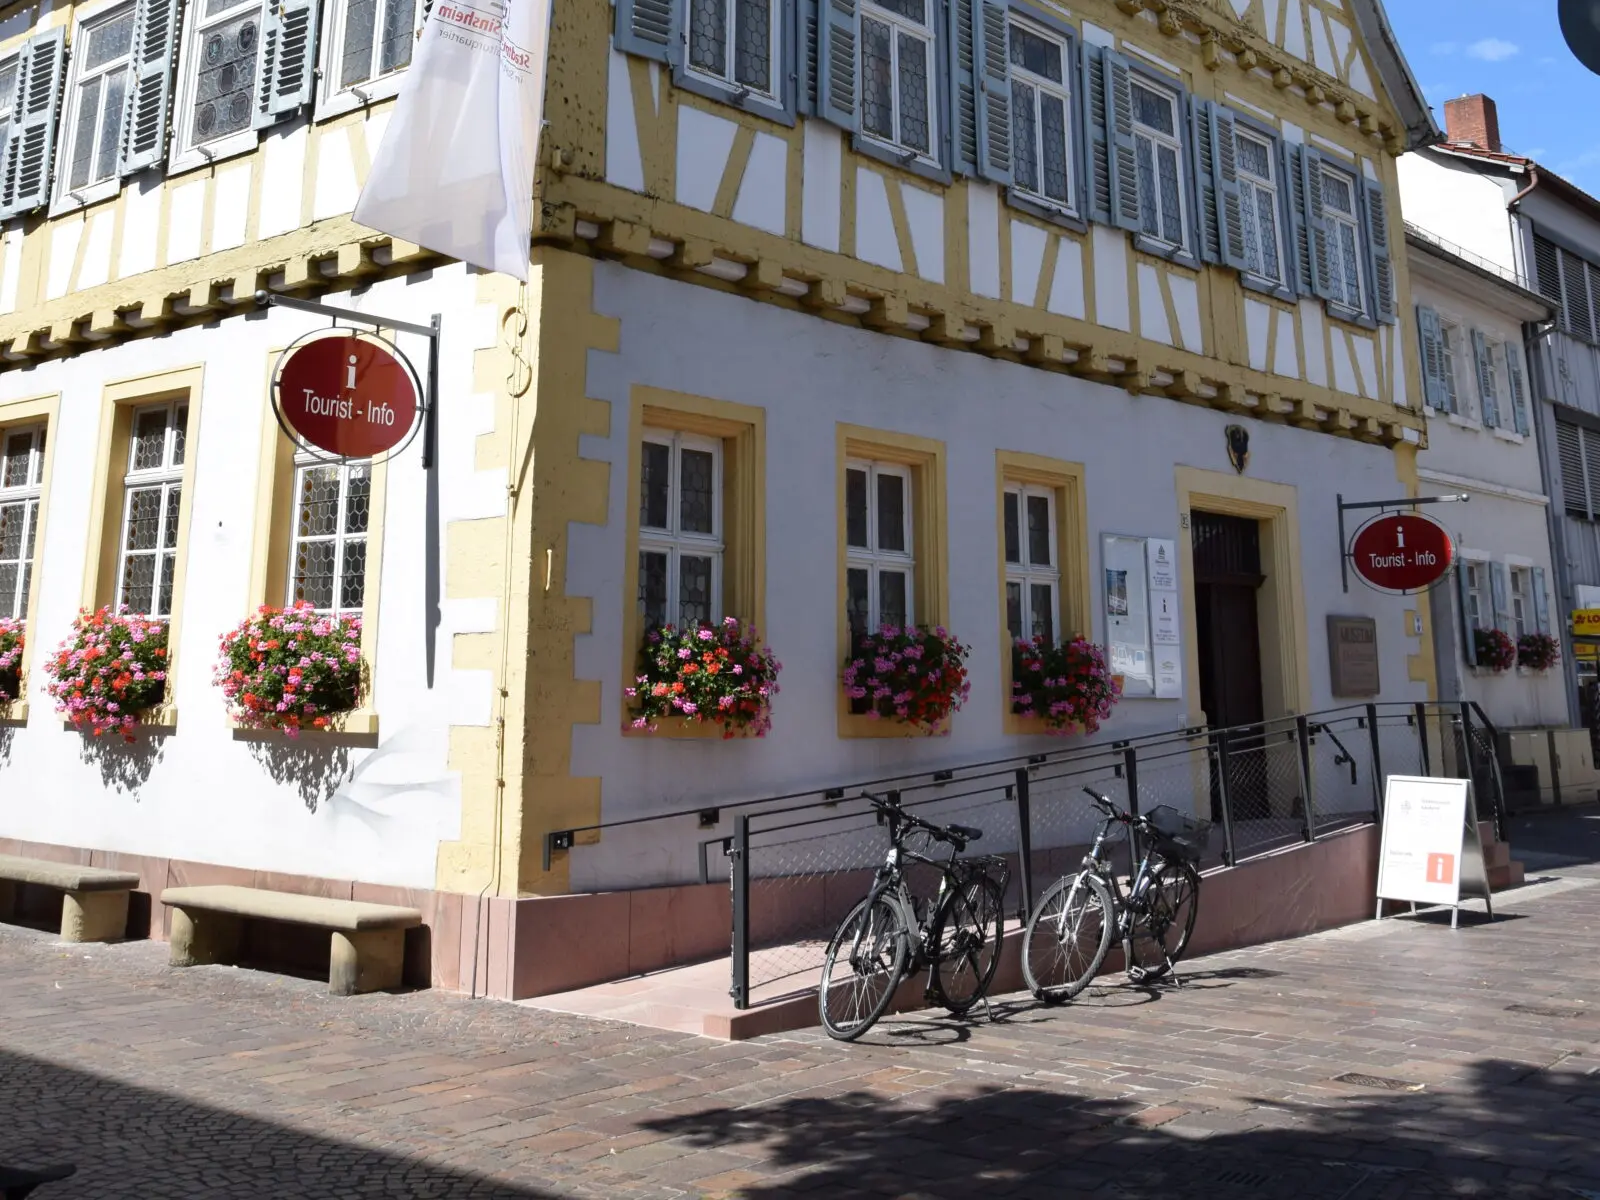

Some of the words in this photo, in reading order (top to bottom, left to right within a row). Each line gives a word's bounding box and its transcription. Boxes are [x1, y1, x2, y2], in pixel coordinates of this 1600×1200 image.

[303, 388, 353, 419] Tourist
[367, 400, 395, 426] Info
[1369, 552, 1406, 568] Tourist
[1415, 550, 1436, 566] Info
